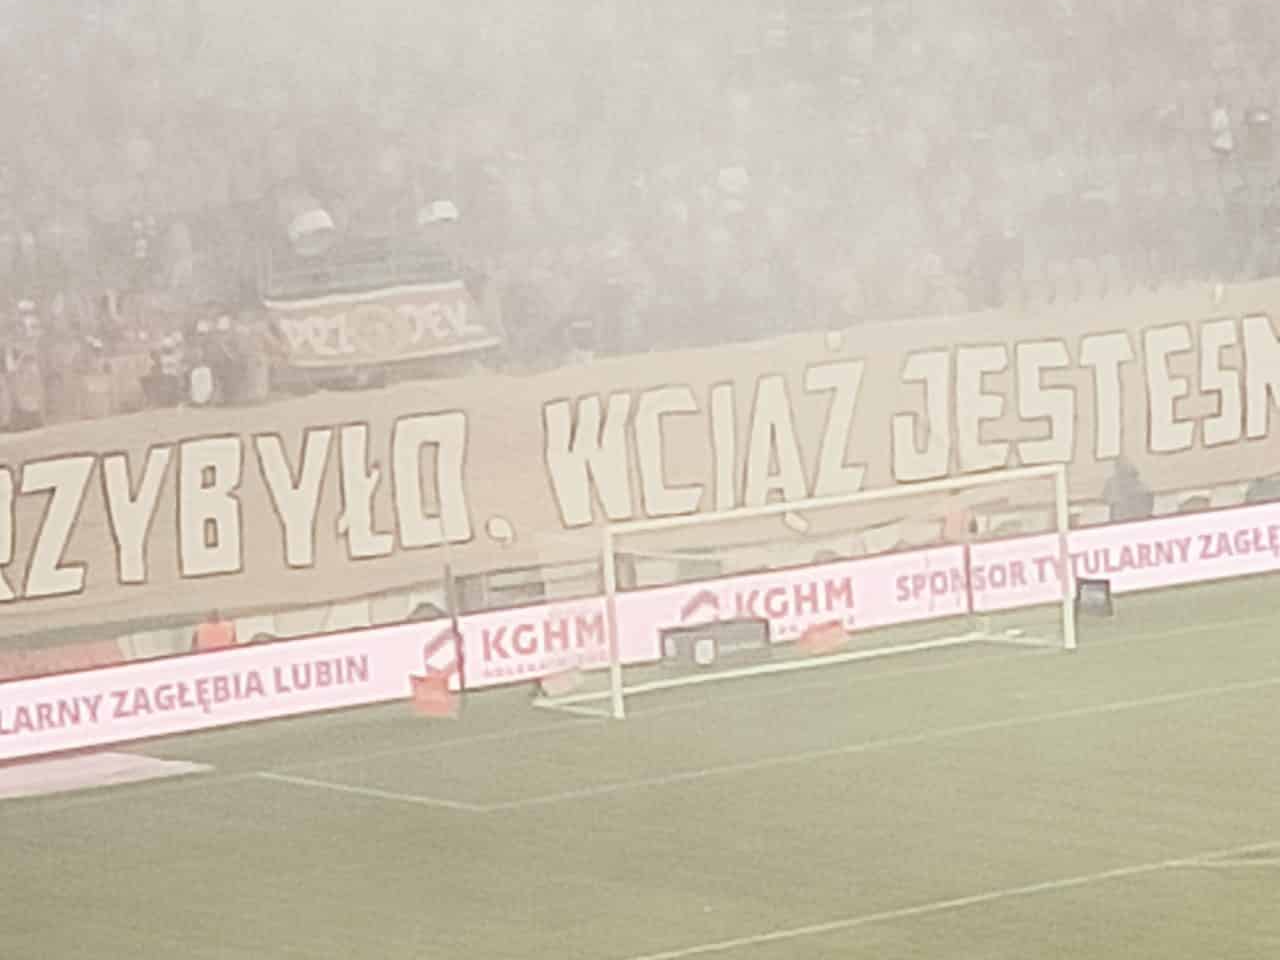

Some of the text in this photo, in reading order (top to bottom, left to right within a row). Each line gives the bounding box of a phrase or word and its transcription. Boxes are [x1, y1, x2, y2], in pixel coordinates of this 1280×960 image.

[735, 576, 855, 620] KGHM
[481, 611, 607, 662] KGHM
[111, 670, 267, 720] ZAGŁĘBIA
[273, 653, 370, 693] LUBIN
